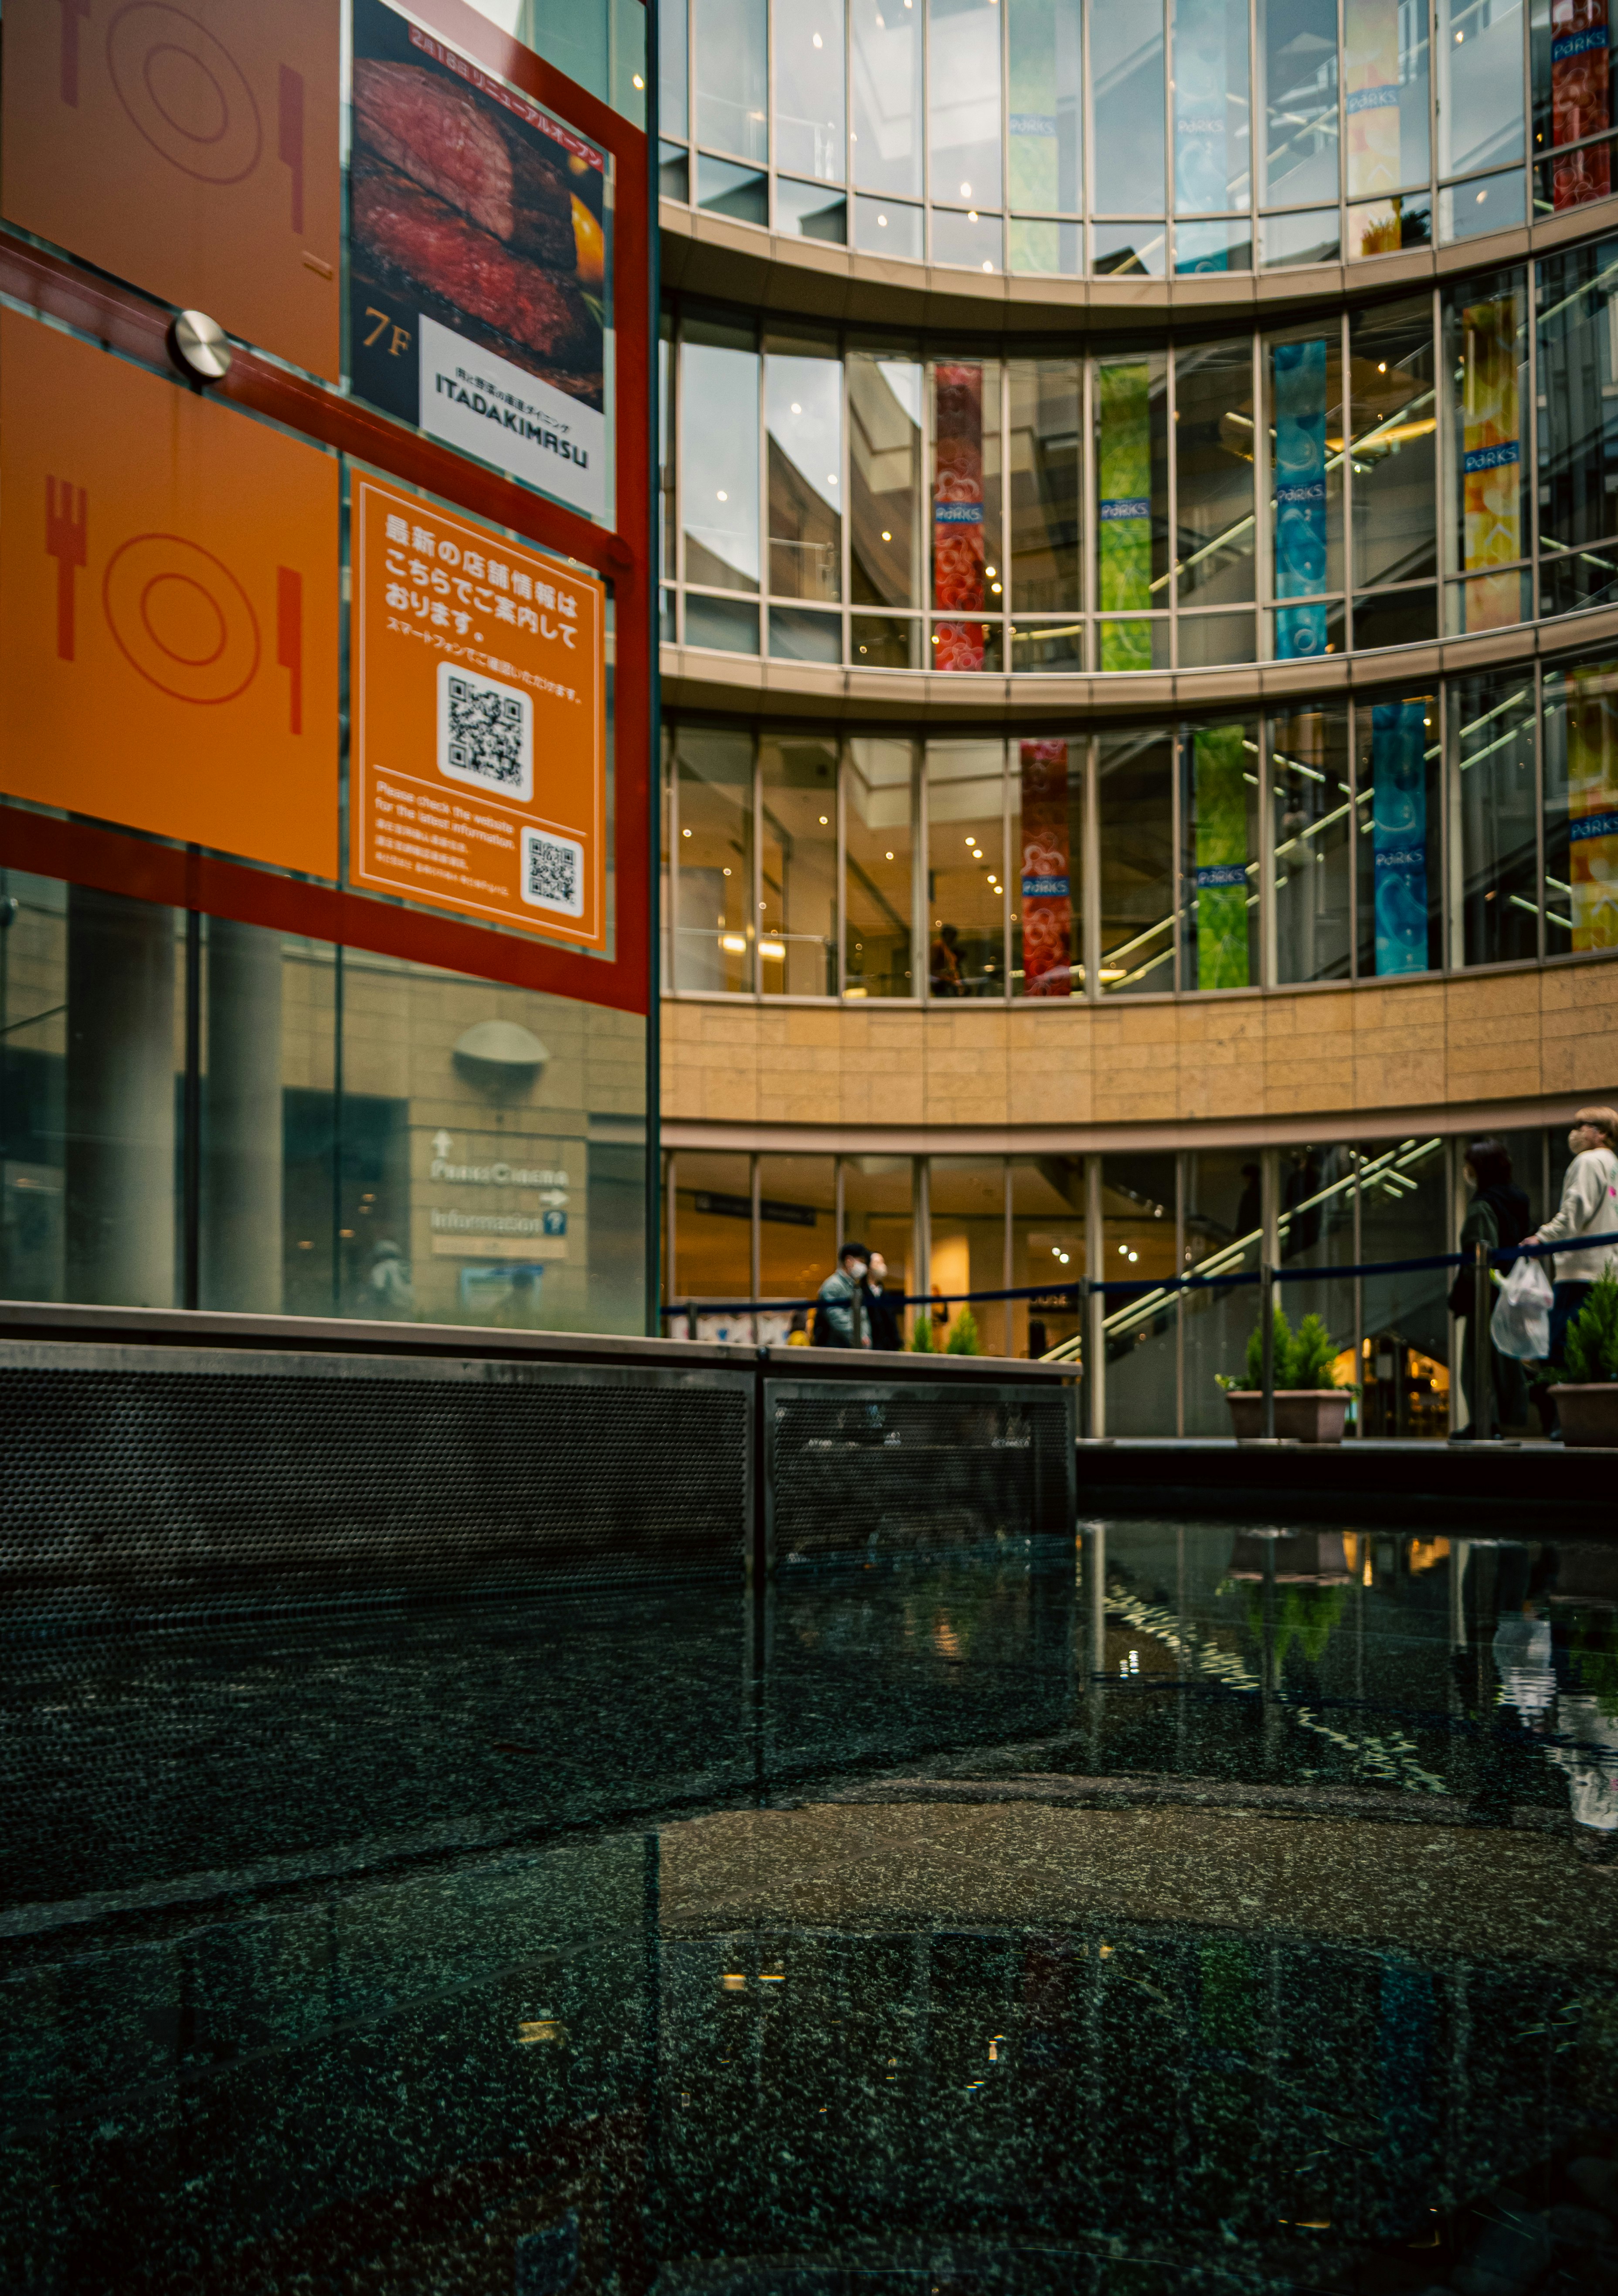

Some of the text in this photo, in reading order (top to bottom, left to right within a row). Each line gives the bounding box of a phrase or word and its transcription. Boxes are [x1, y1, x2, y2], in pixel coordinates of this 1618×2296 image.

[474, 68, 602, 165] リニューアルオープン
[364, 306, 412, 356] 7F
[436, 372, 588, 469] ITADAKIMASU
[386, 514, 578, 618] 最新の店舗情報は
[386, 548, 578, 650] こちらでご案内して
[385, 582, 484, 642] おります。
[375, 797, 393, 812] for
[396, 805, 415, 820] the
[418, 810, 450, 829] latest
[377, 781, 514, 834] Please check the website
